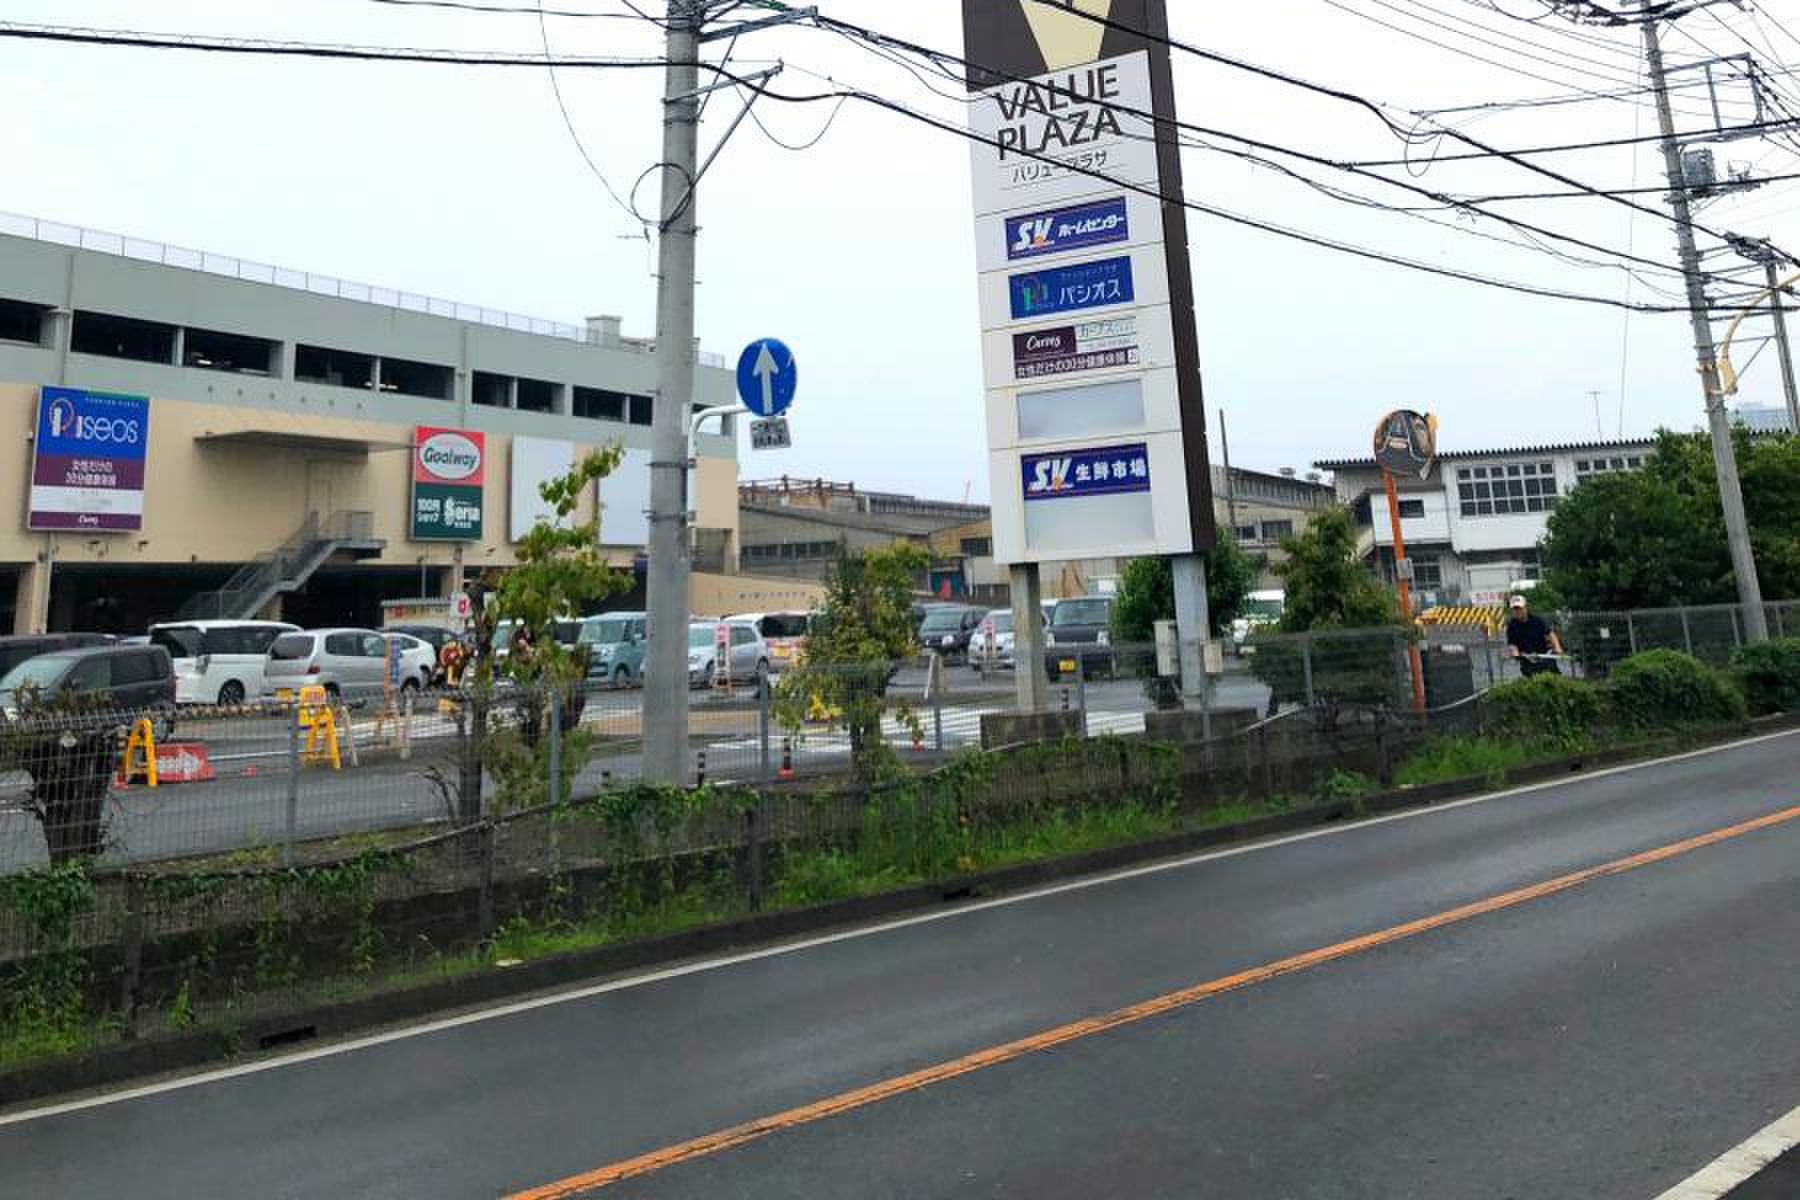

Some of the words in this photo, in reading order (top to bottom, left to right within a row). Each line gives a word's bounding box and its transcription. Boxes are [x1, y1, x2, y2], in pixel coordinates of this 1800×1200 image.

[995, 63, 1119, 122] VALUE
[998, 106, 1122, 161] PLAZA
[1058, 214, 1124, 238] ホームセンター
[1059, 279, 1121, 305] パシオス
[1075, 457, 1147, 482] 生鮮市場
